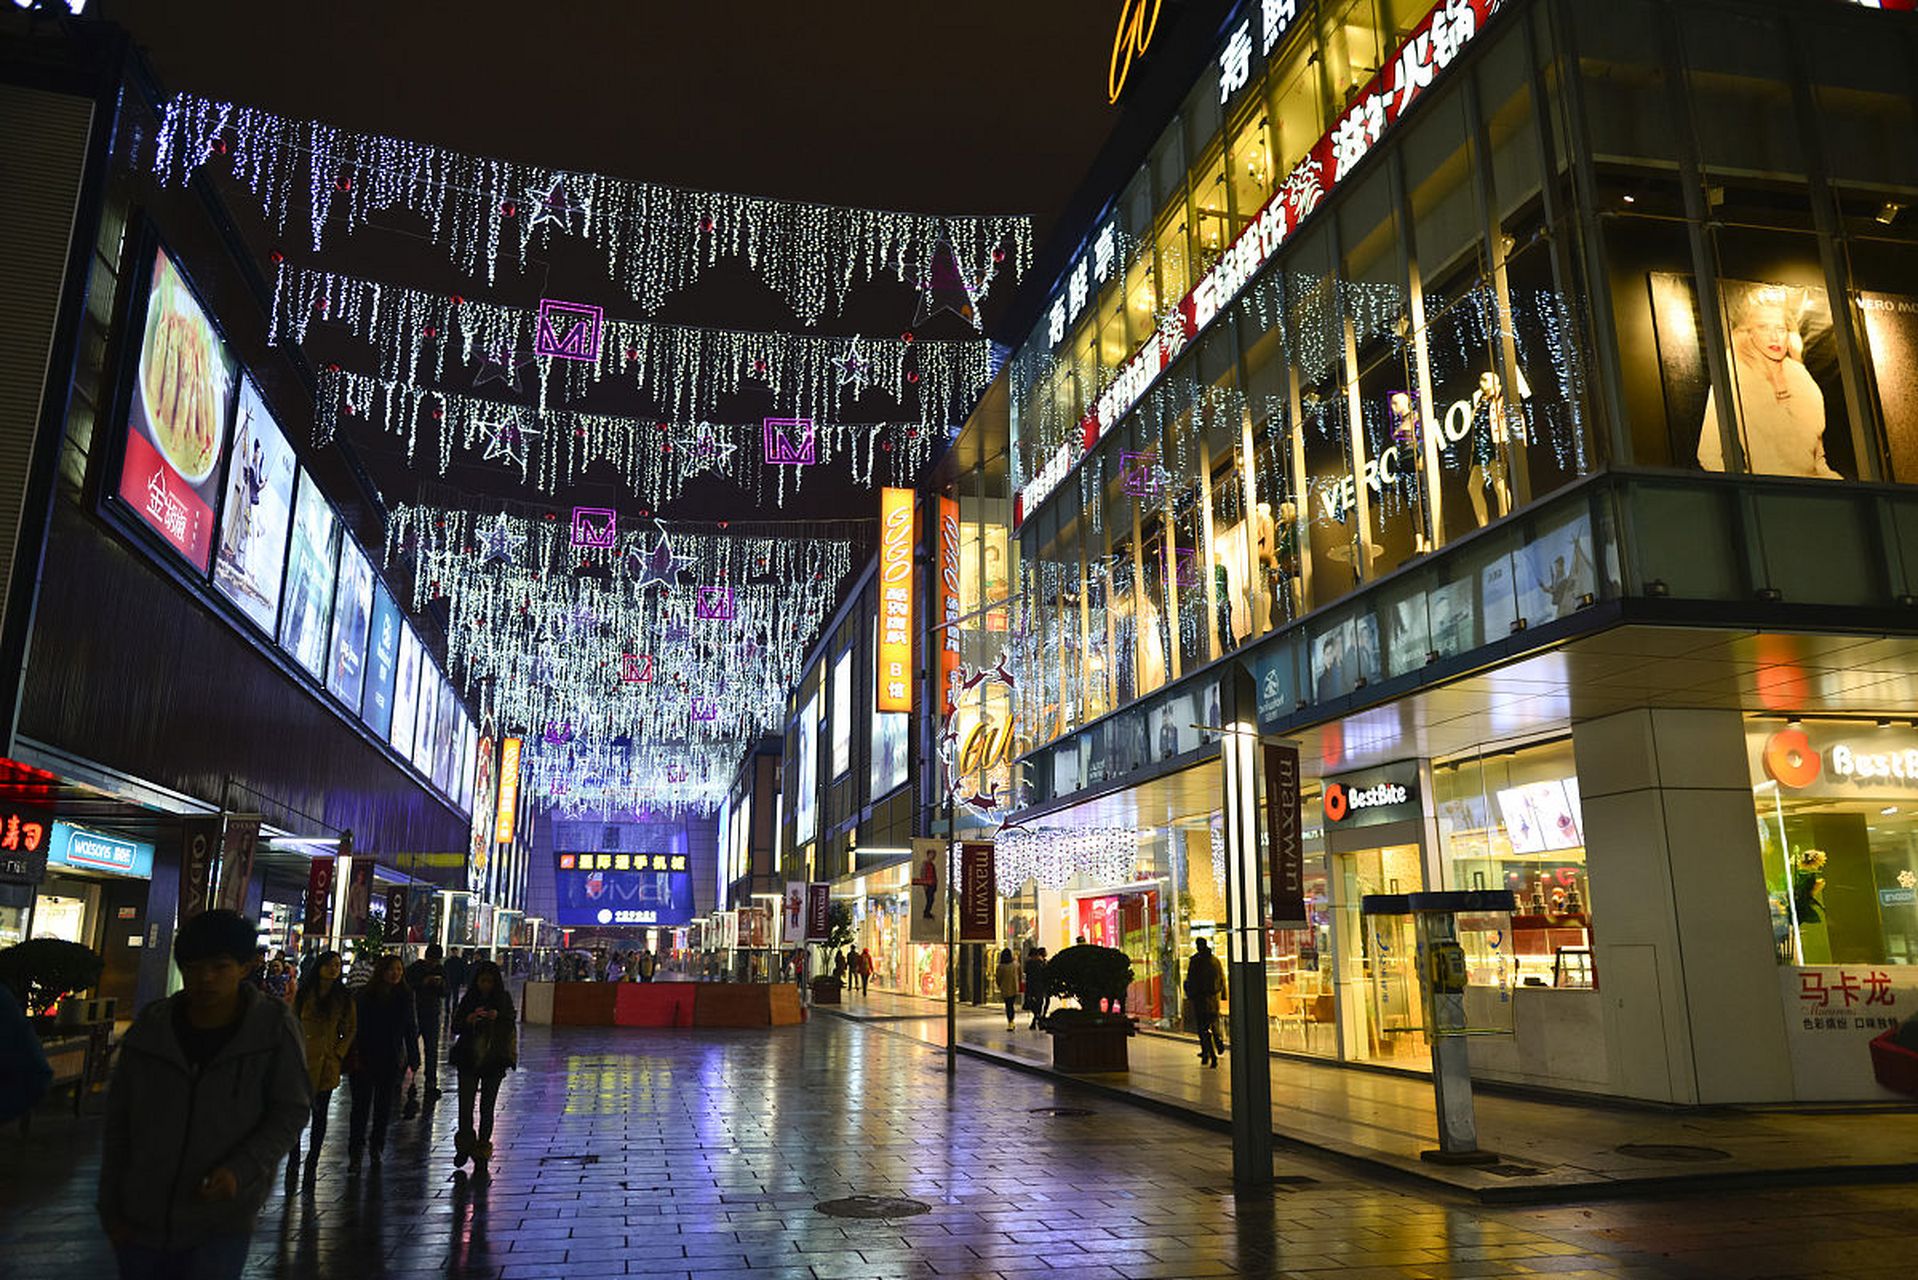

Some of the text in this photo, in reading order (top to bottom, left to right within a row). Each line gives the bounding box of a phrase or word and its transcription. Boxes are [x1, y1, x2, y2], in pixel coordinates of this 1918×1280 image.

[1348, 783, 1407, 810] BestBite
[0, 813, 43, 852] 寿司
[1279, 759, 1298, 892] maxwin
[975, 850, 990, 925] maxwin
[1798, 971, 1895, 1008] 马卡龙
